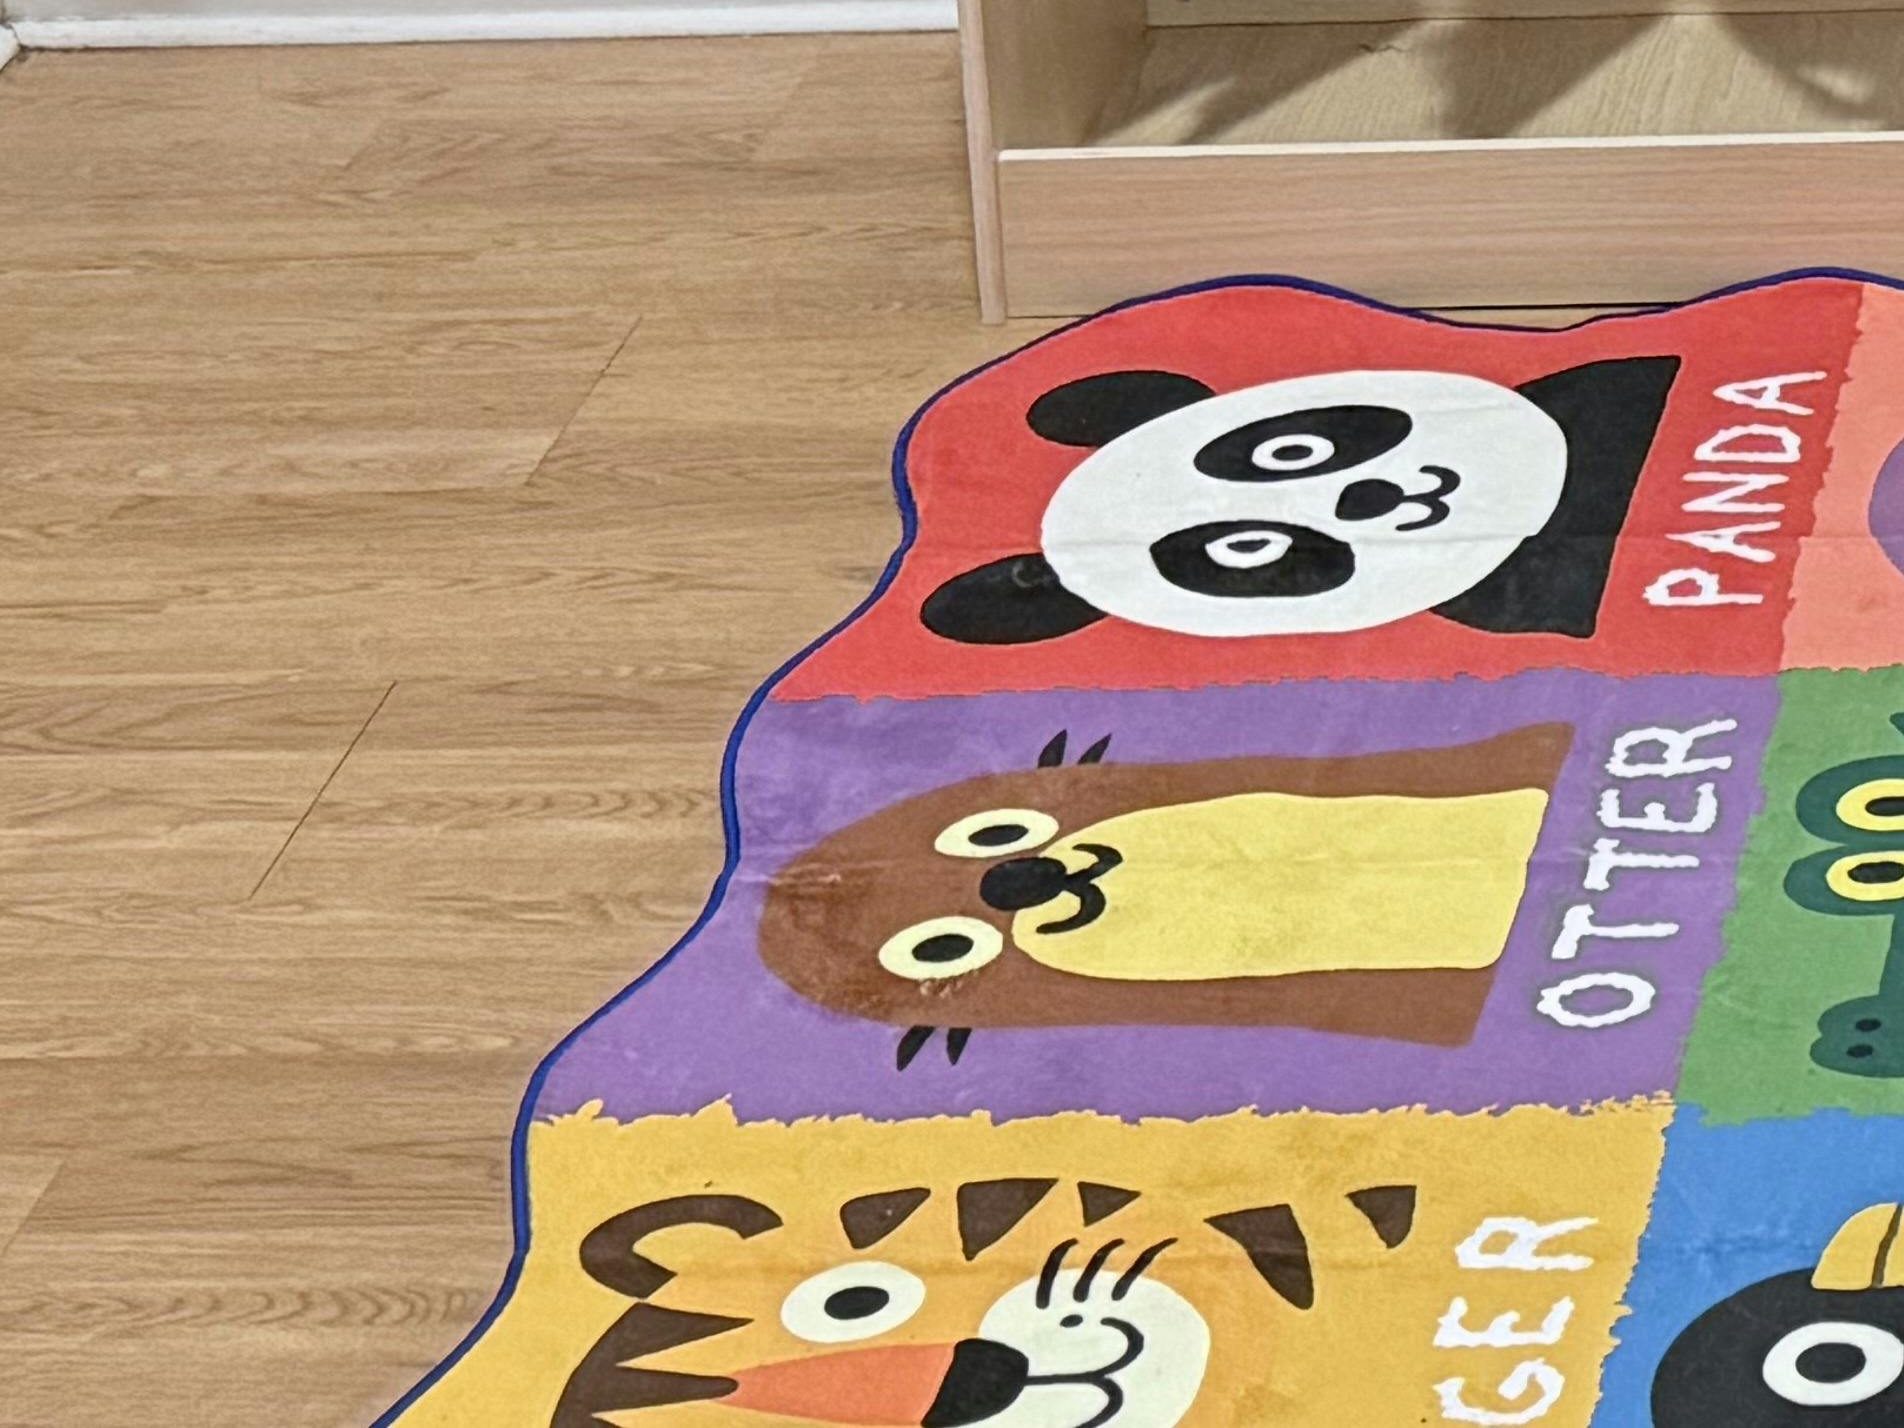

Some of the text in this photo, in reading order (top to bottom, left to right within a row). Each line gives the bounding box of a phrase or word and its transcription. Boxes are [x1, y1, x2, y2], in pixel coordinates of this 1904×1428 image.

[1643, 370, 1826, 607] PANDA
[1536, 717, 1738, 1028] OTTER
[1432, 1216, 1600, 1428] GER
